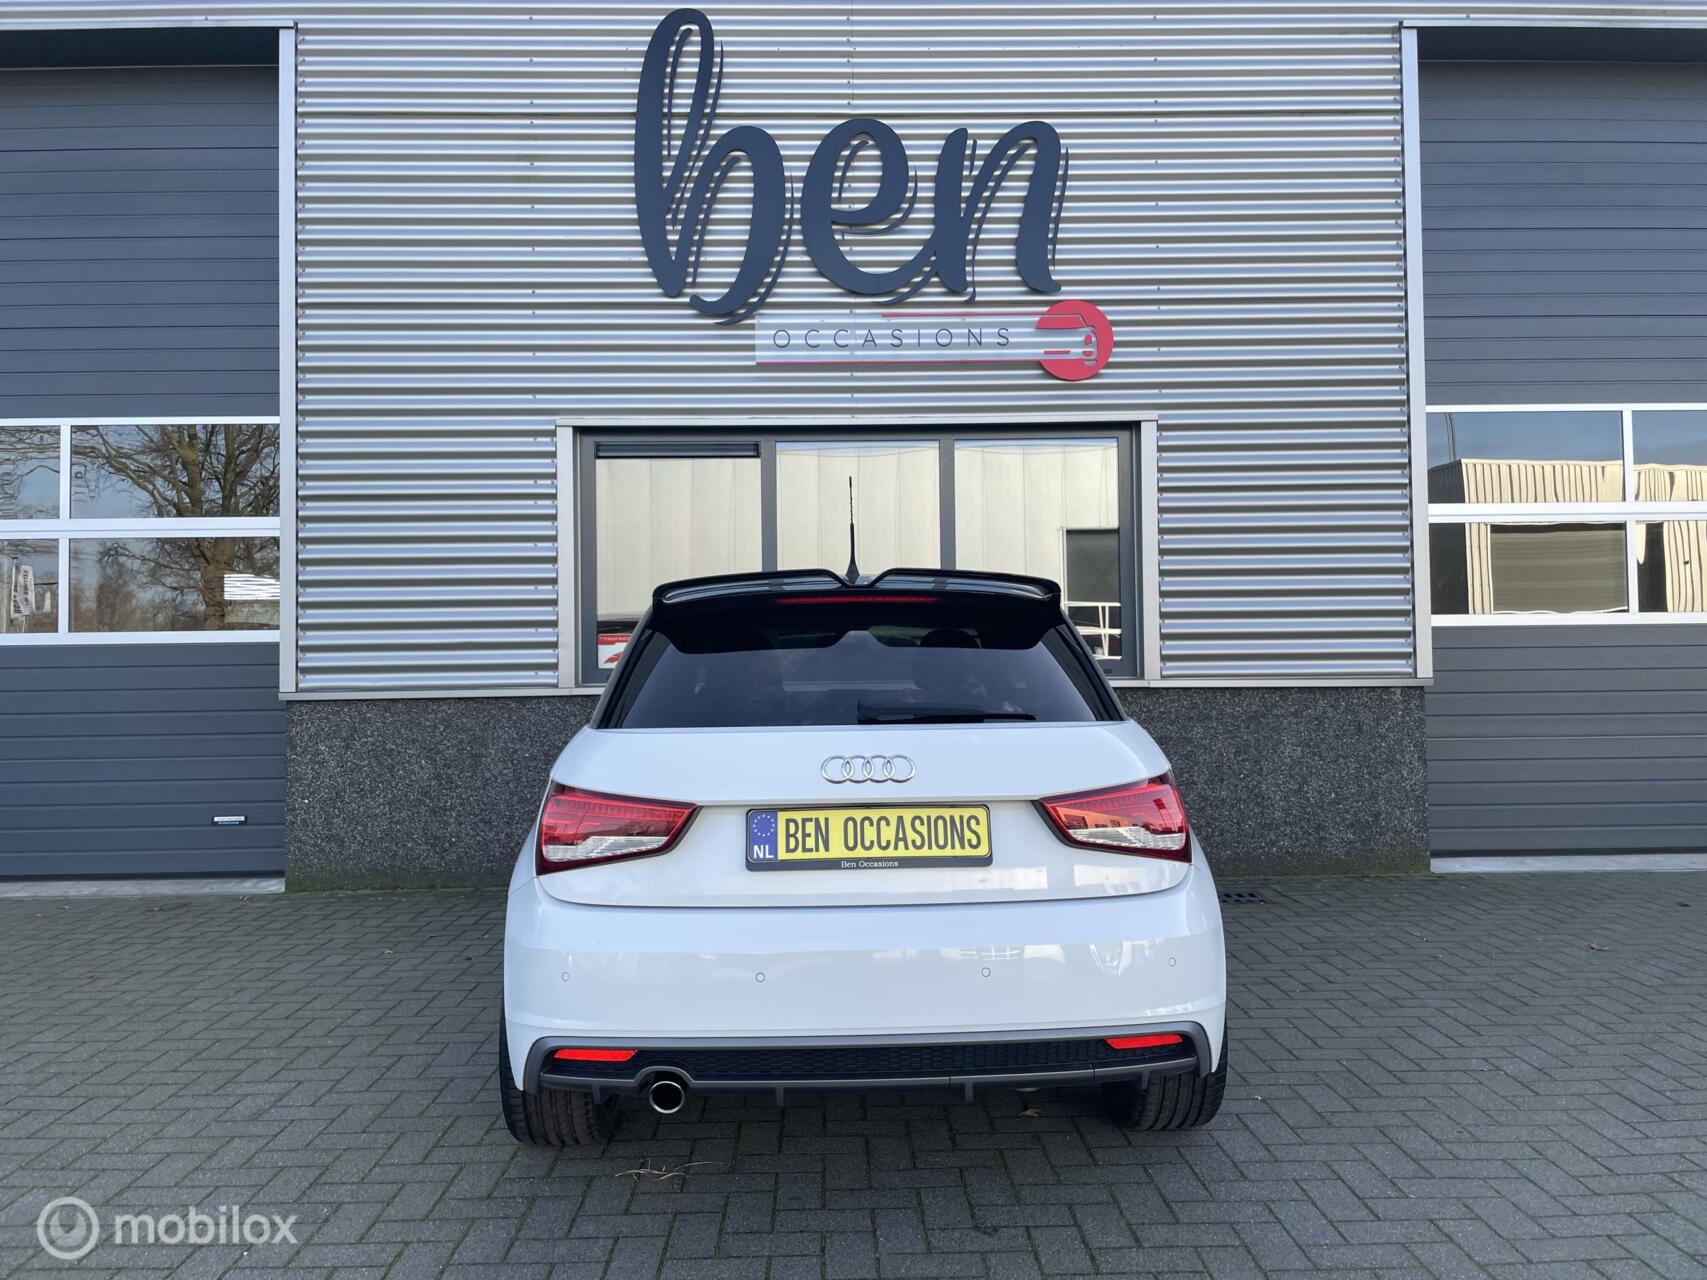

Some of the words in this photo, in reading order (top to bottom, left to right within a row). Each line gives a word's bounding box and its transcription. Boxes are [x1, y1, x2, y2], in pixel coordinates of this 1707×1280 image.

[634, 8, 1069, 325] ben
[773, 327, 1011, 349] OCCASIONS
[784, 817, 830, 853] BEN
[843, 814, 981, 851] OCCASIONS
[753, 845, 774, 858] NL
[841, 860, 857, 868] Ben
[858, 859, 899, 868] Occasions
